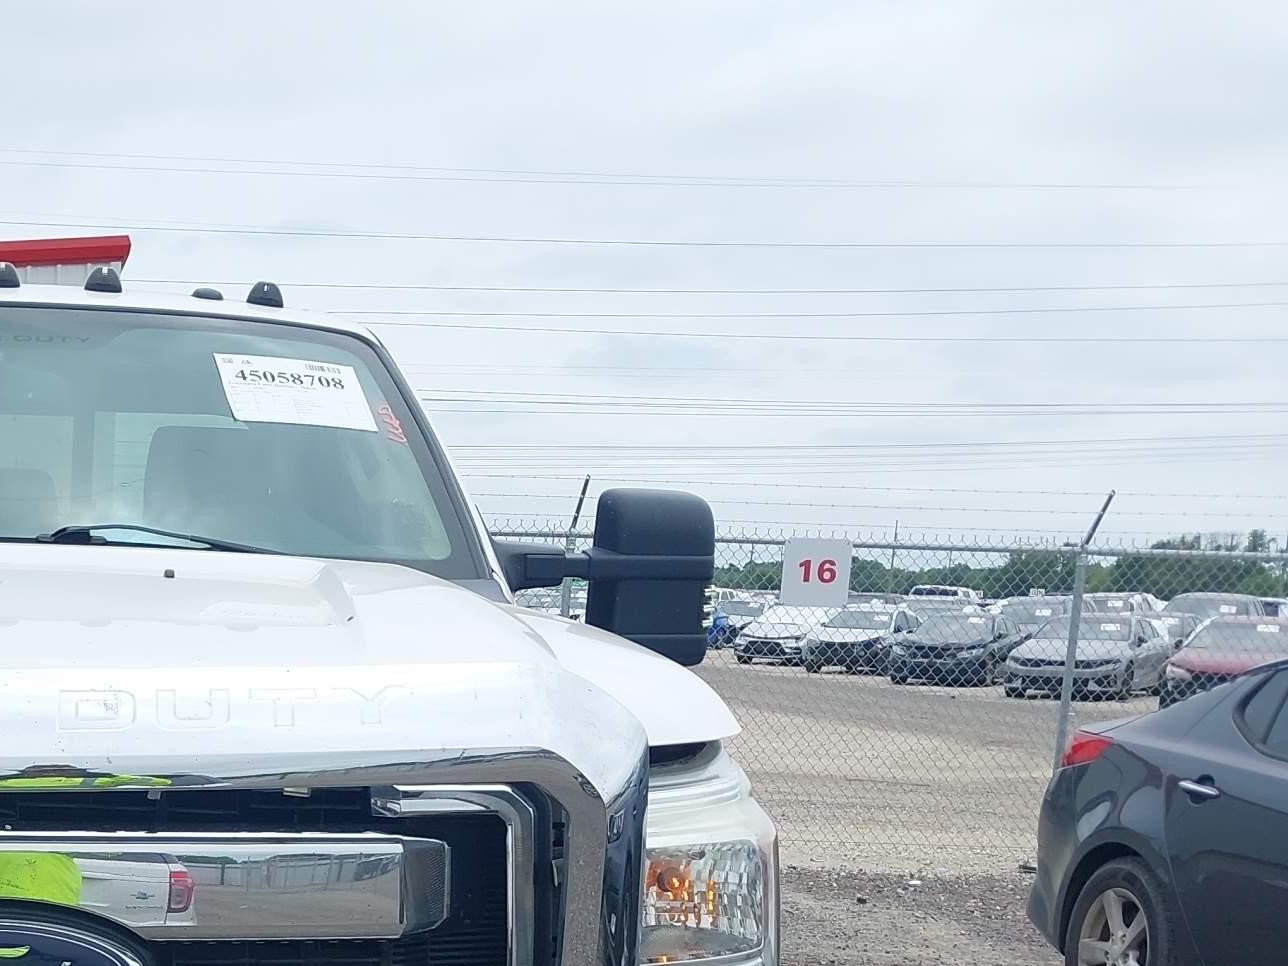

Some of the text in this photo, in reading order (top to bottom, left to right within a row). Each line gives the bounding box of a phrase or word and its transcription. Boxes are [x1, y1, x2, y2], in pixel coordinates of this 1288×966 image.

[13, 334, 92, 343] DUTY
[234, 369, 345, 390] 45058708
[798, 559, 837, 583] 16
[56, 685, 409, 733] DUTY
